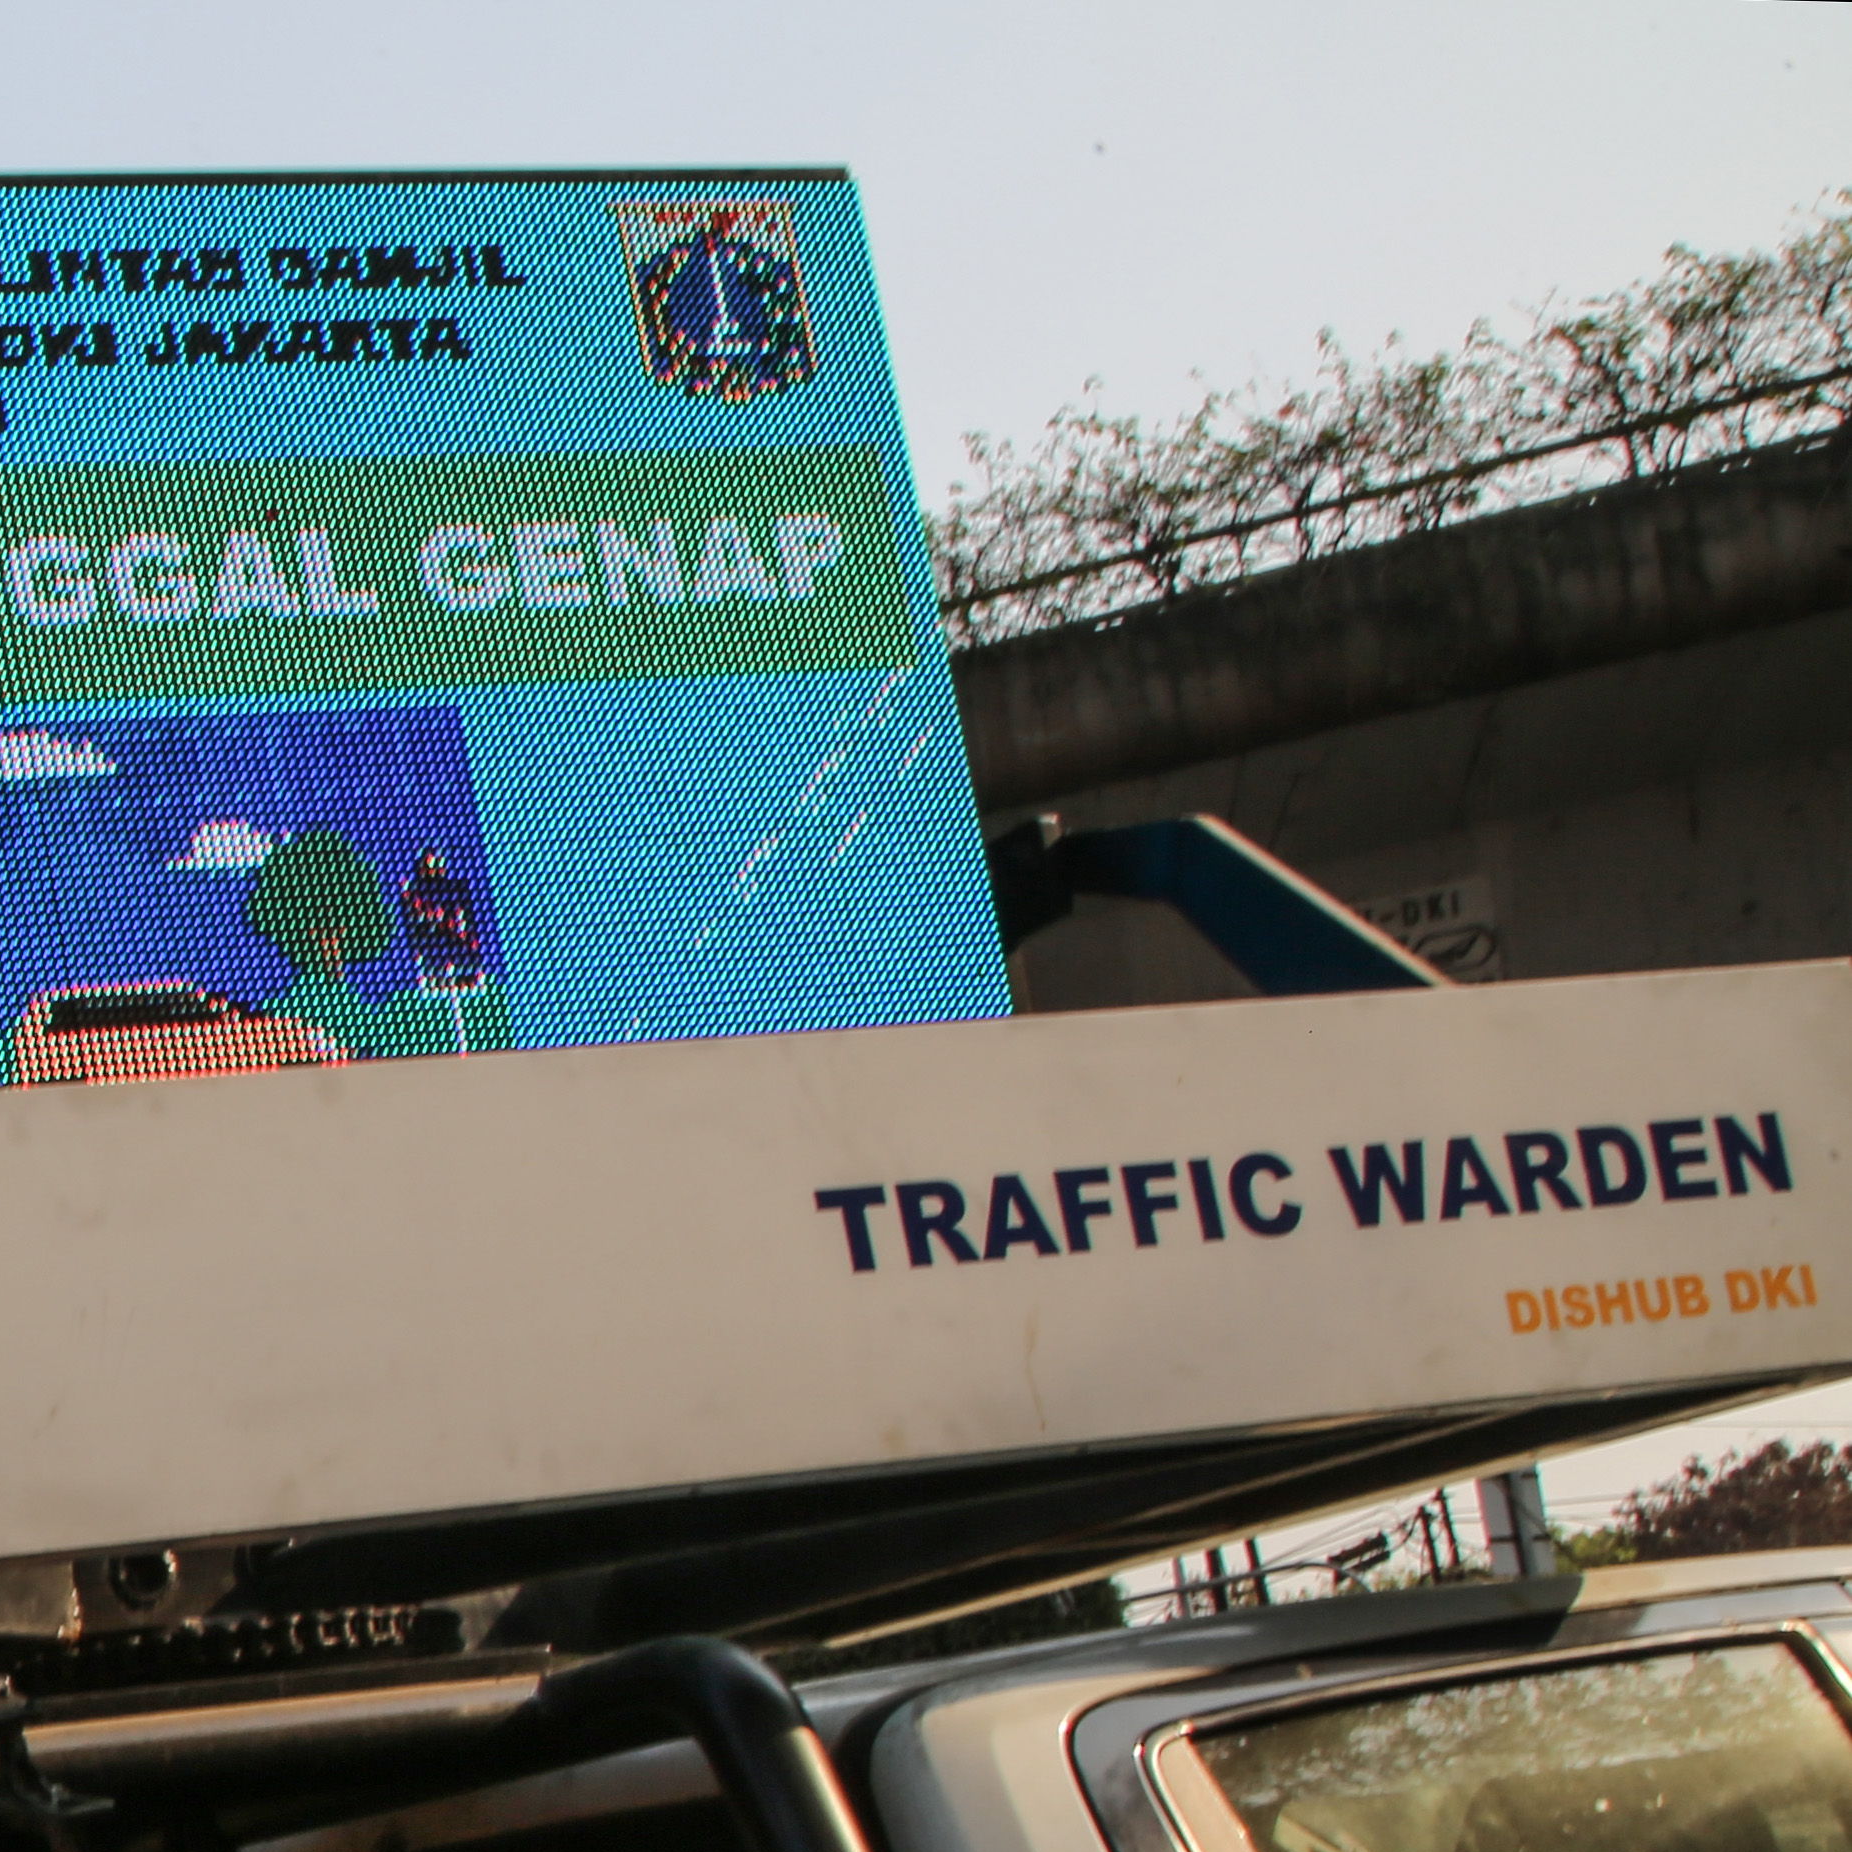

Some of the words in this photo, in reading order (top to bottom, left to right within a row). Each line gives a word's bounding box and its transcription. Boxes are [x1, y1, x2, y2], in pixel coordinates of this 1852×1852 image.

[142, 313, 472, 367] JAKARTA
[415, 511, 843, 615] GENAP
[813, 1150, 1303, 1274] TRAFFIC
[1328, 1110, 1794, 1229] WARDEN
[1505, 1275, 1713, 1335] DISHUB
[1725, 1263, 1819, 1317] DKI
